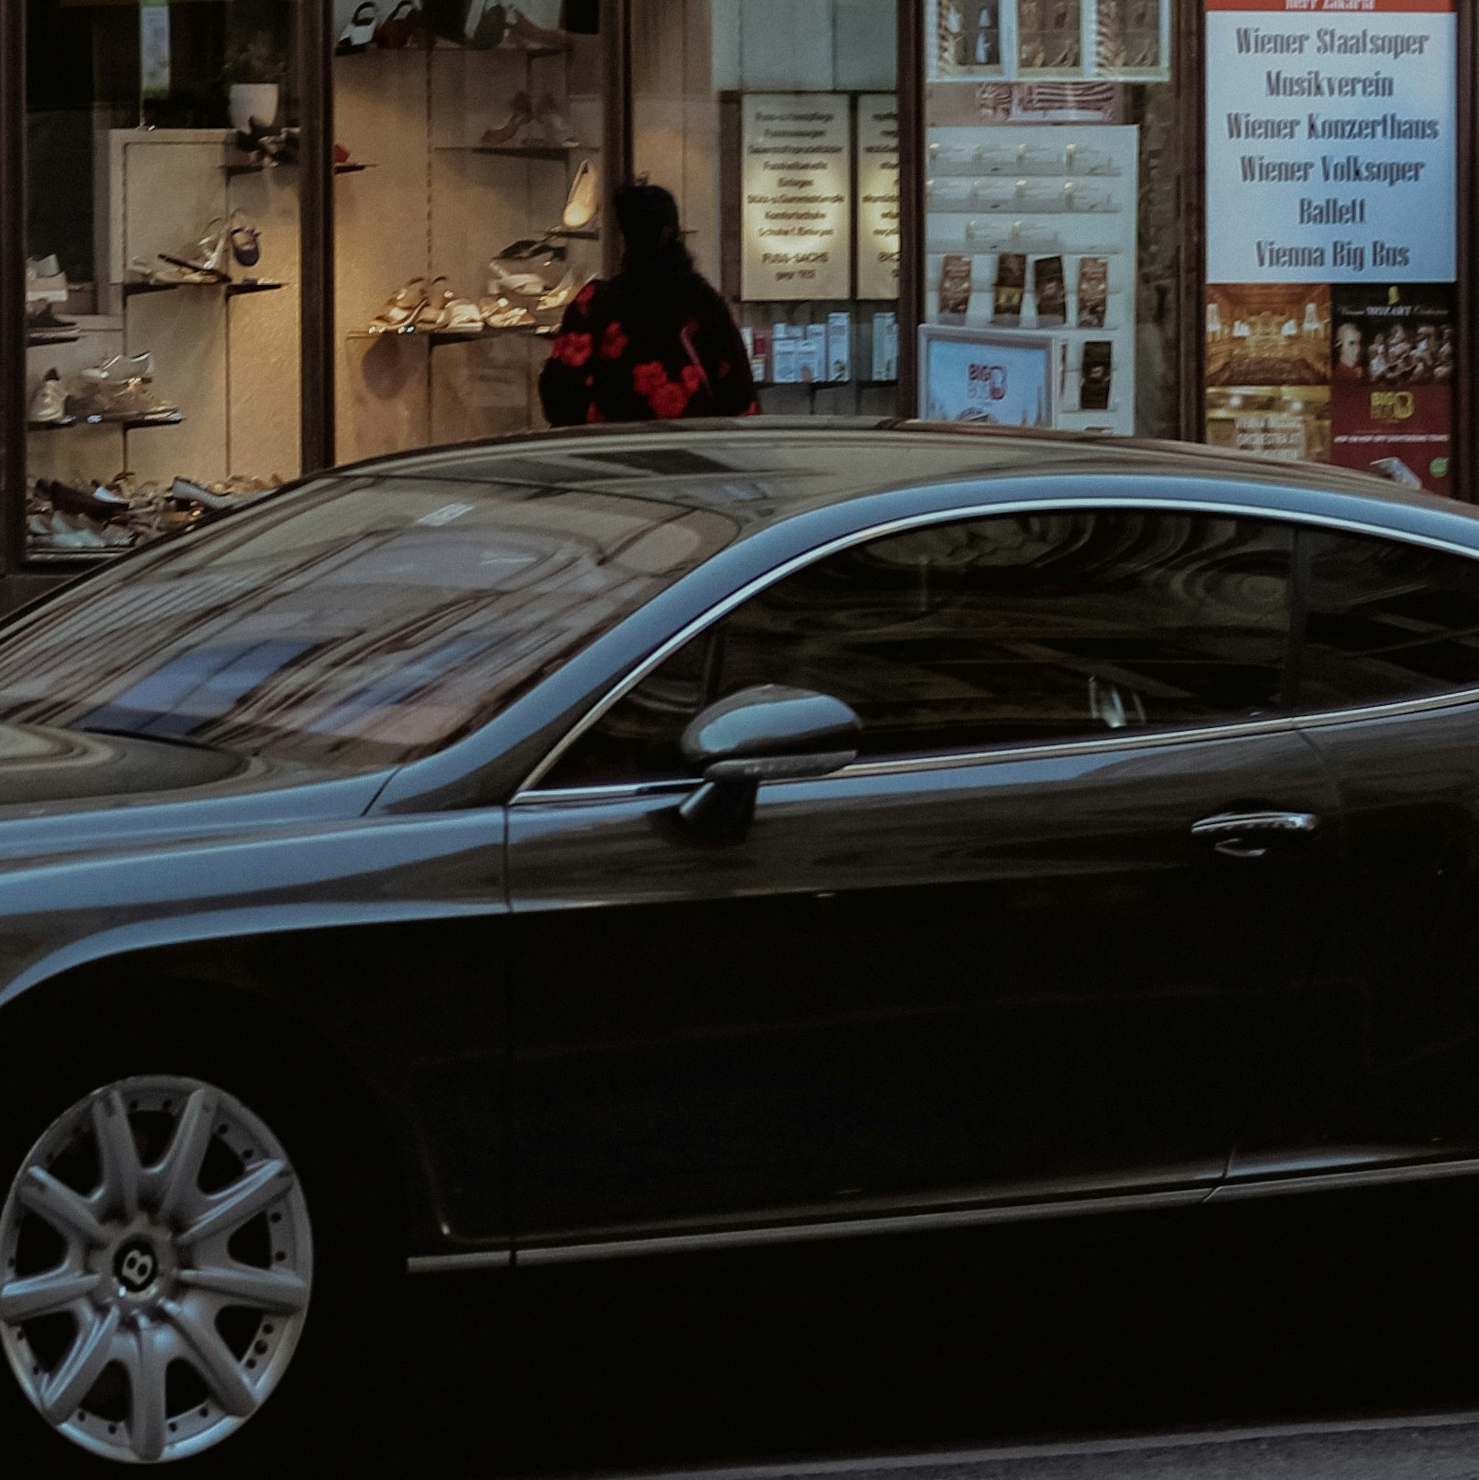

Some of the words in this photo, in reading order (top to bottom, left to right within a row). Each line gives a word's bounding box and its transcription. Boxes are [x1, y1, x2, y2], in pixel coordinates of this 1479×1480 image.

[1236, 27, 1310, 54] Wiener
[1317, 27, 1430, 60] Staatsoper
[1265, 70, 1395, 98] Musikverein
[1226, 112, 1301, 140] Wiener
[1307, 113, 1440, 140] Konzerthaus
[1240, 155, 1315, 182] Wiener
[1322, 155, 1426, 187] Volksoper
[1299, 197, 1366, 225] Ballett
[1256, 240, 1325, 268] Vienna
[1332, 240, 1365, 272] Big
[1372, 240, 1410, 268] Bus
